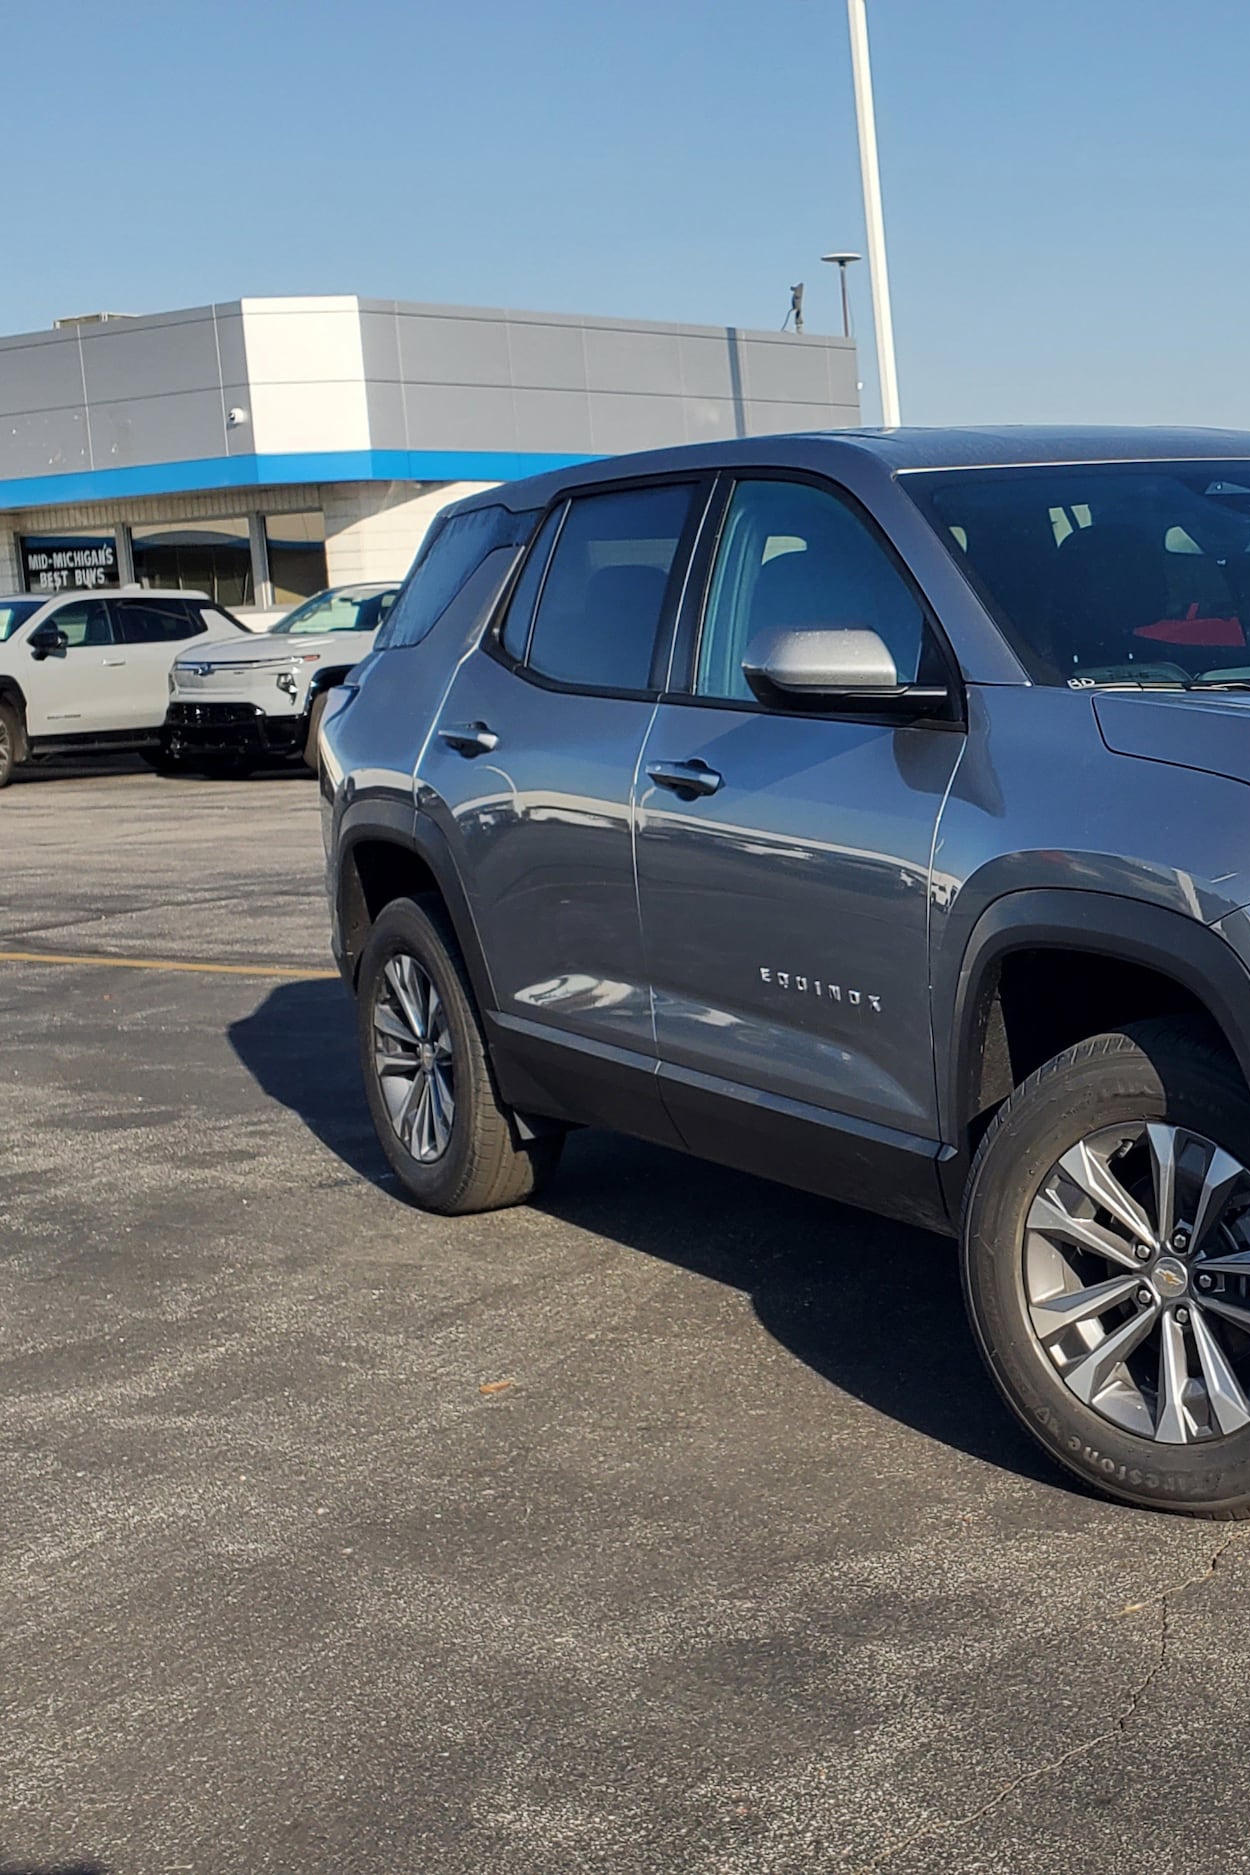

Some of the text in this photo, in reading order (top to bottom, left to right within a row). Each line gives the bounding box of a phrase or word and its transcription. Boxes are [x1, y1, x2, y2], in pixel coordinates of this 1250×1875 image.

[28, 542, 114, 571] MID-MICHIGAN'S
[40, 567, 105, 589] BEST BUYS
[760, 967, 881, 1012] EQUINOX
